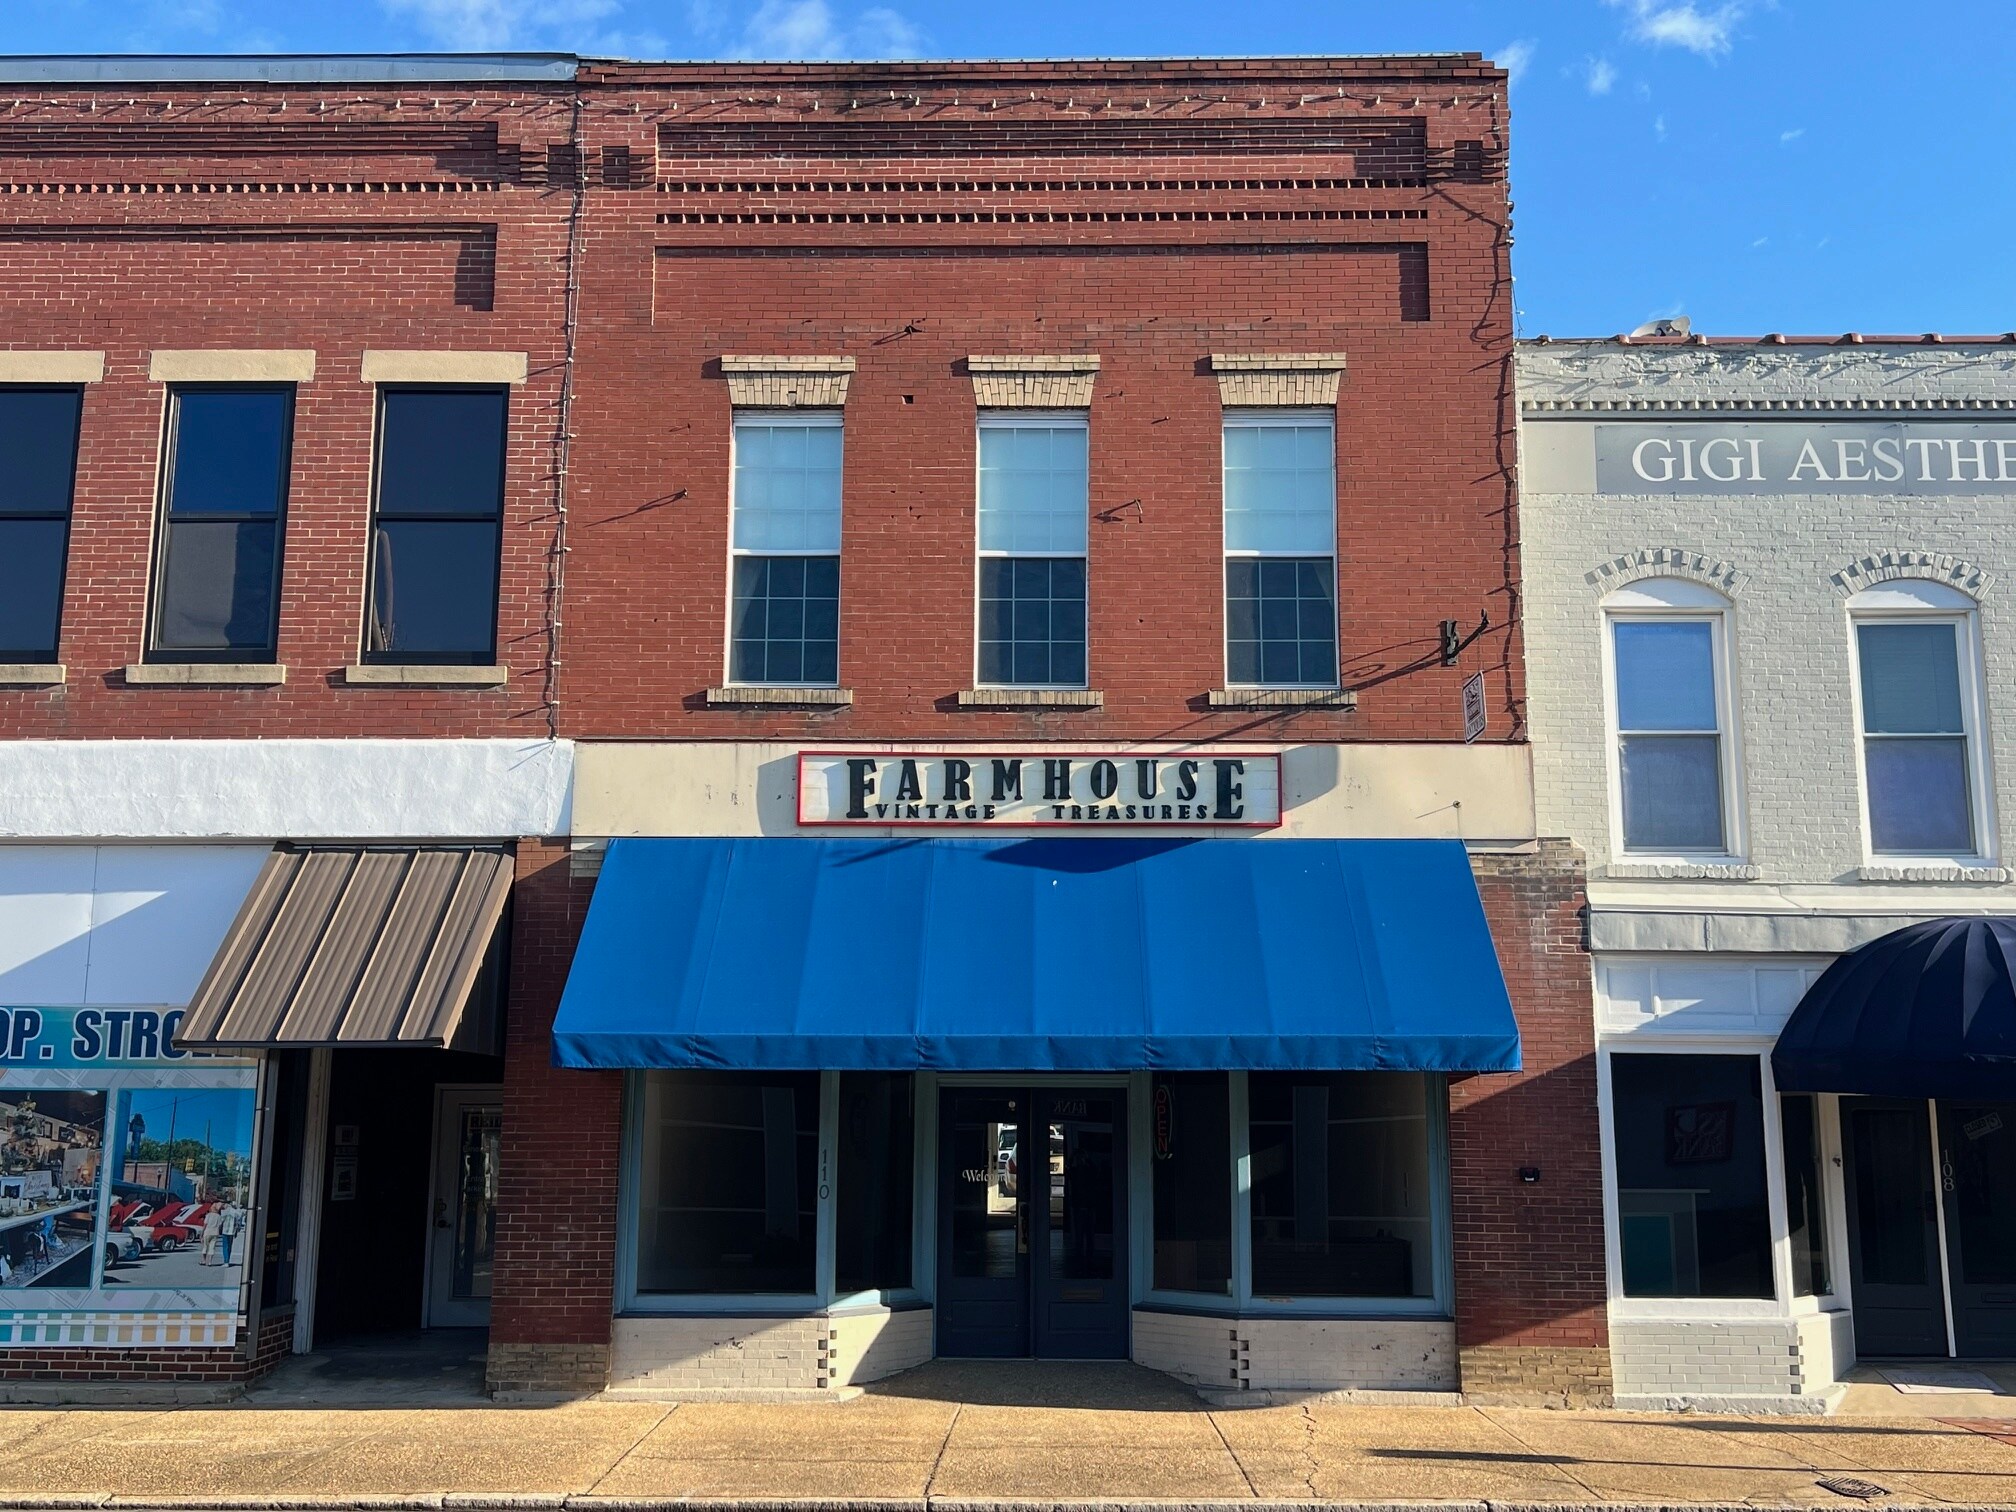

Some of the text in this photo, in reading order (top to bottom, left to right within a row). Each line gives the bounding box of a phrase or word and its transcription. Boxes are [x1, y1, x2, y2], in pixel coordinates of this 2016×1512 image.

[1631, 437, 1767, 483] GIGI
[845, 757, 1246, 820] FARMHOUSE
[874, 803, 1210, 821] VINTAGE TREASURES
[73, 1008, 230, 1060] STRO
[1155, 1088, 1168, 1152] OPEN
[818, 1148, 830, 1200] 110
[1942, 1148, 1955, 1192] 108
